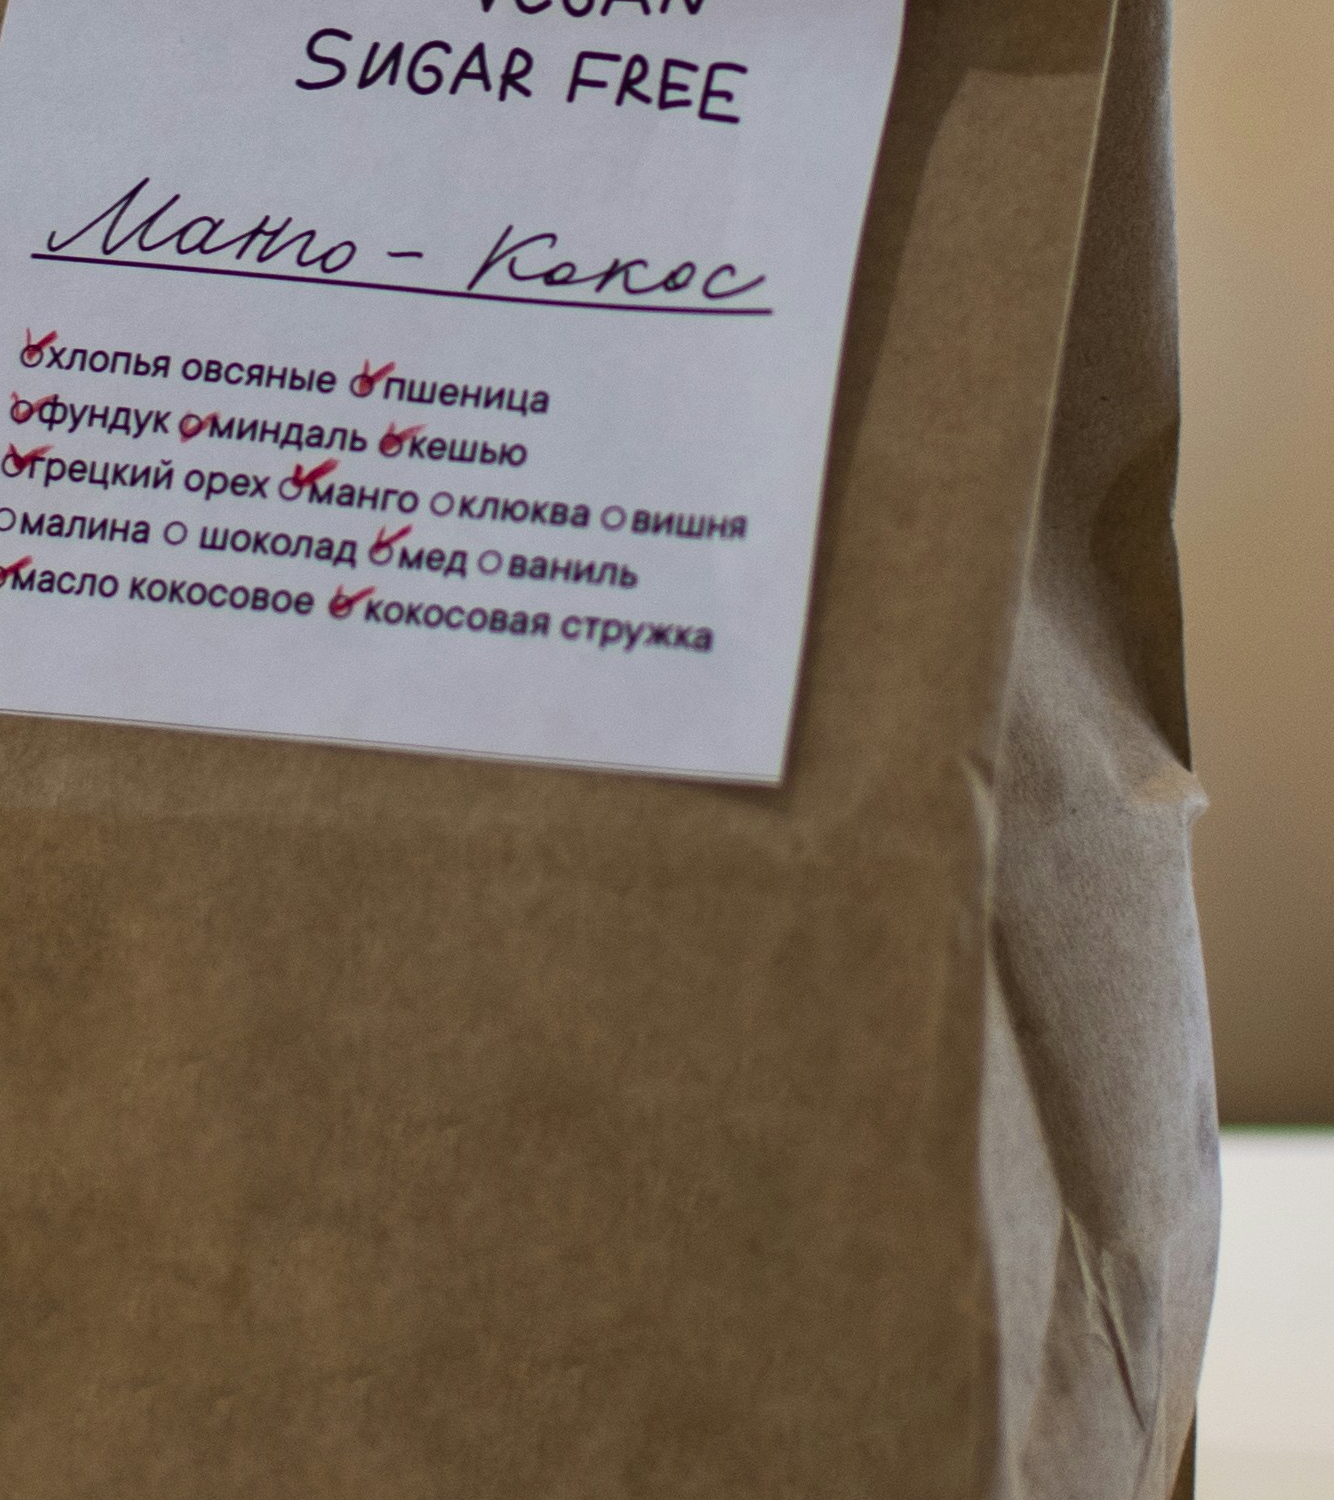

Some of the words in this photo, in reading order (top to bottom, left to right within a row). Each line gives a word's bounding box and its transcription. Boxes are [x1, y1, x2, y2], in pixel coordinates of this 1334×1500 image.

[295, 27, 535, 100] SUGAR
[566, 49, 749, 124] FREE
[46, 176, 357, 275] Манго
[466, 223, 768, 302] Кокос
[47, 345, 171, 379] хлопья
[180, 358, 338, 394] овсяные
[383, 377, 551, 416] пшеница
[37, 396, 172, 439] фундук
[208, 414, 368, 454] миндаль
[407, 435, 529, 468] кешью
[27, 456, 175, 492] грецкий
[183, 468, 269, 502] орех
[309, 479, 420, 516] манго
[459, 492, 591, 531] клюква
[631, 509, 749, 541] вишня
[19, 512, 151, 546] малина
[199, 524, 358, 568] шоколад
[397, 543, 469, 578] мед
[506, 555, 640, 591] ваниль
[10, 566, 121, 600] масло
[128, 576, 315, 617] кокосовое
[363, 598, 551, 640] кокосовая
[560, 616, 715, 655] стружка
